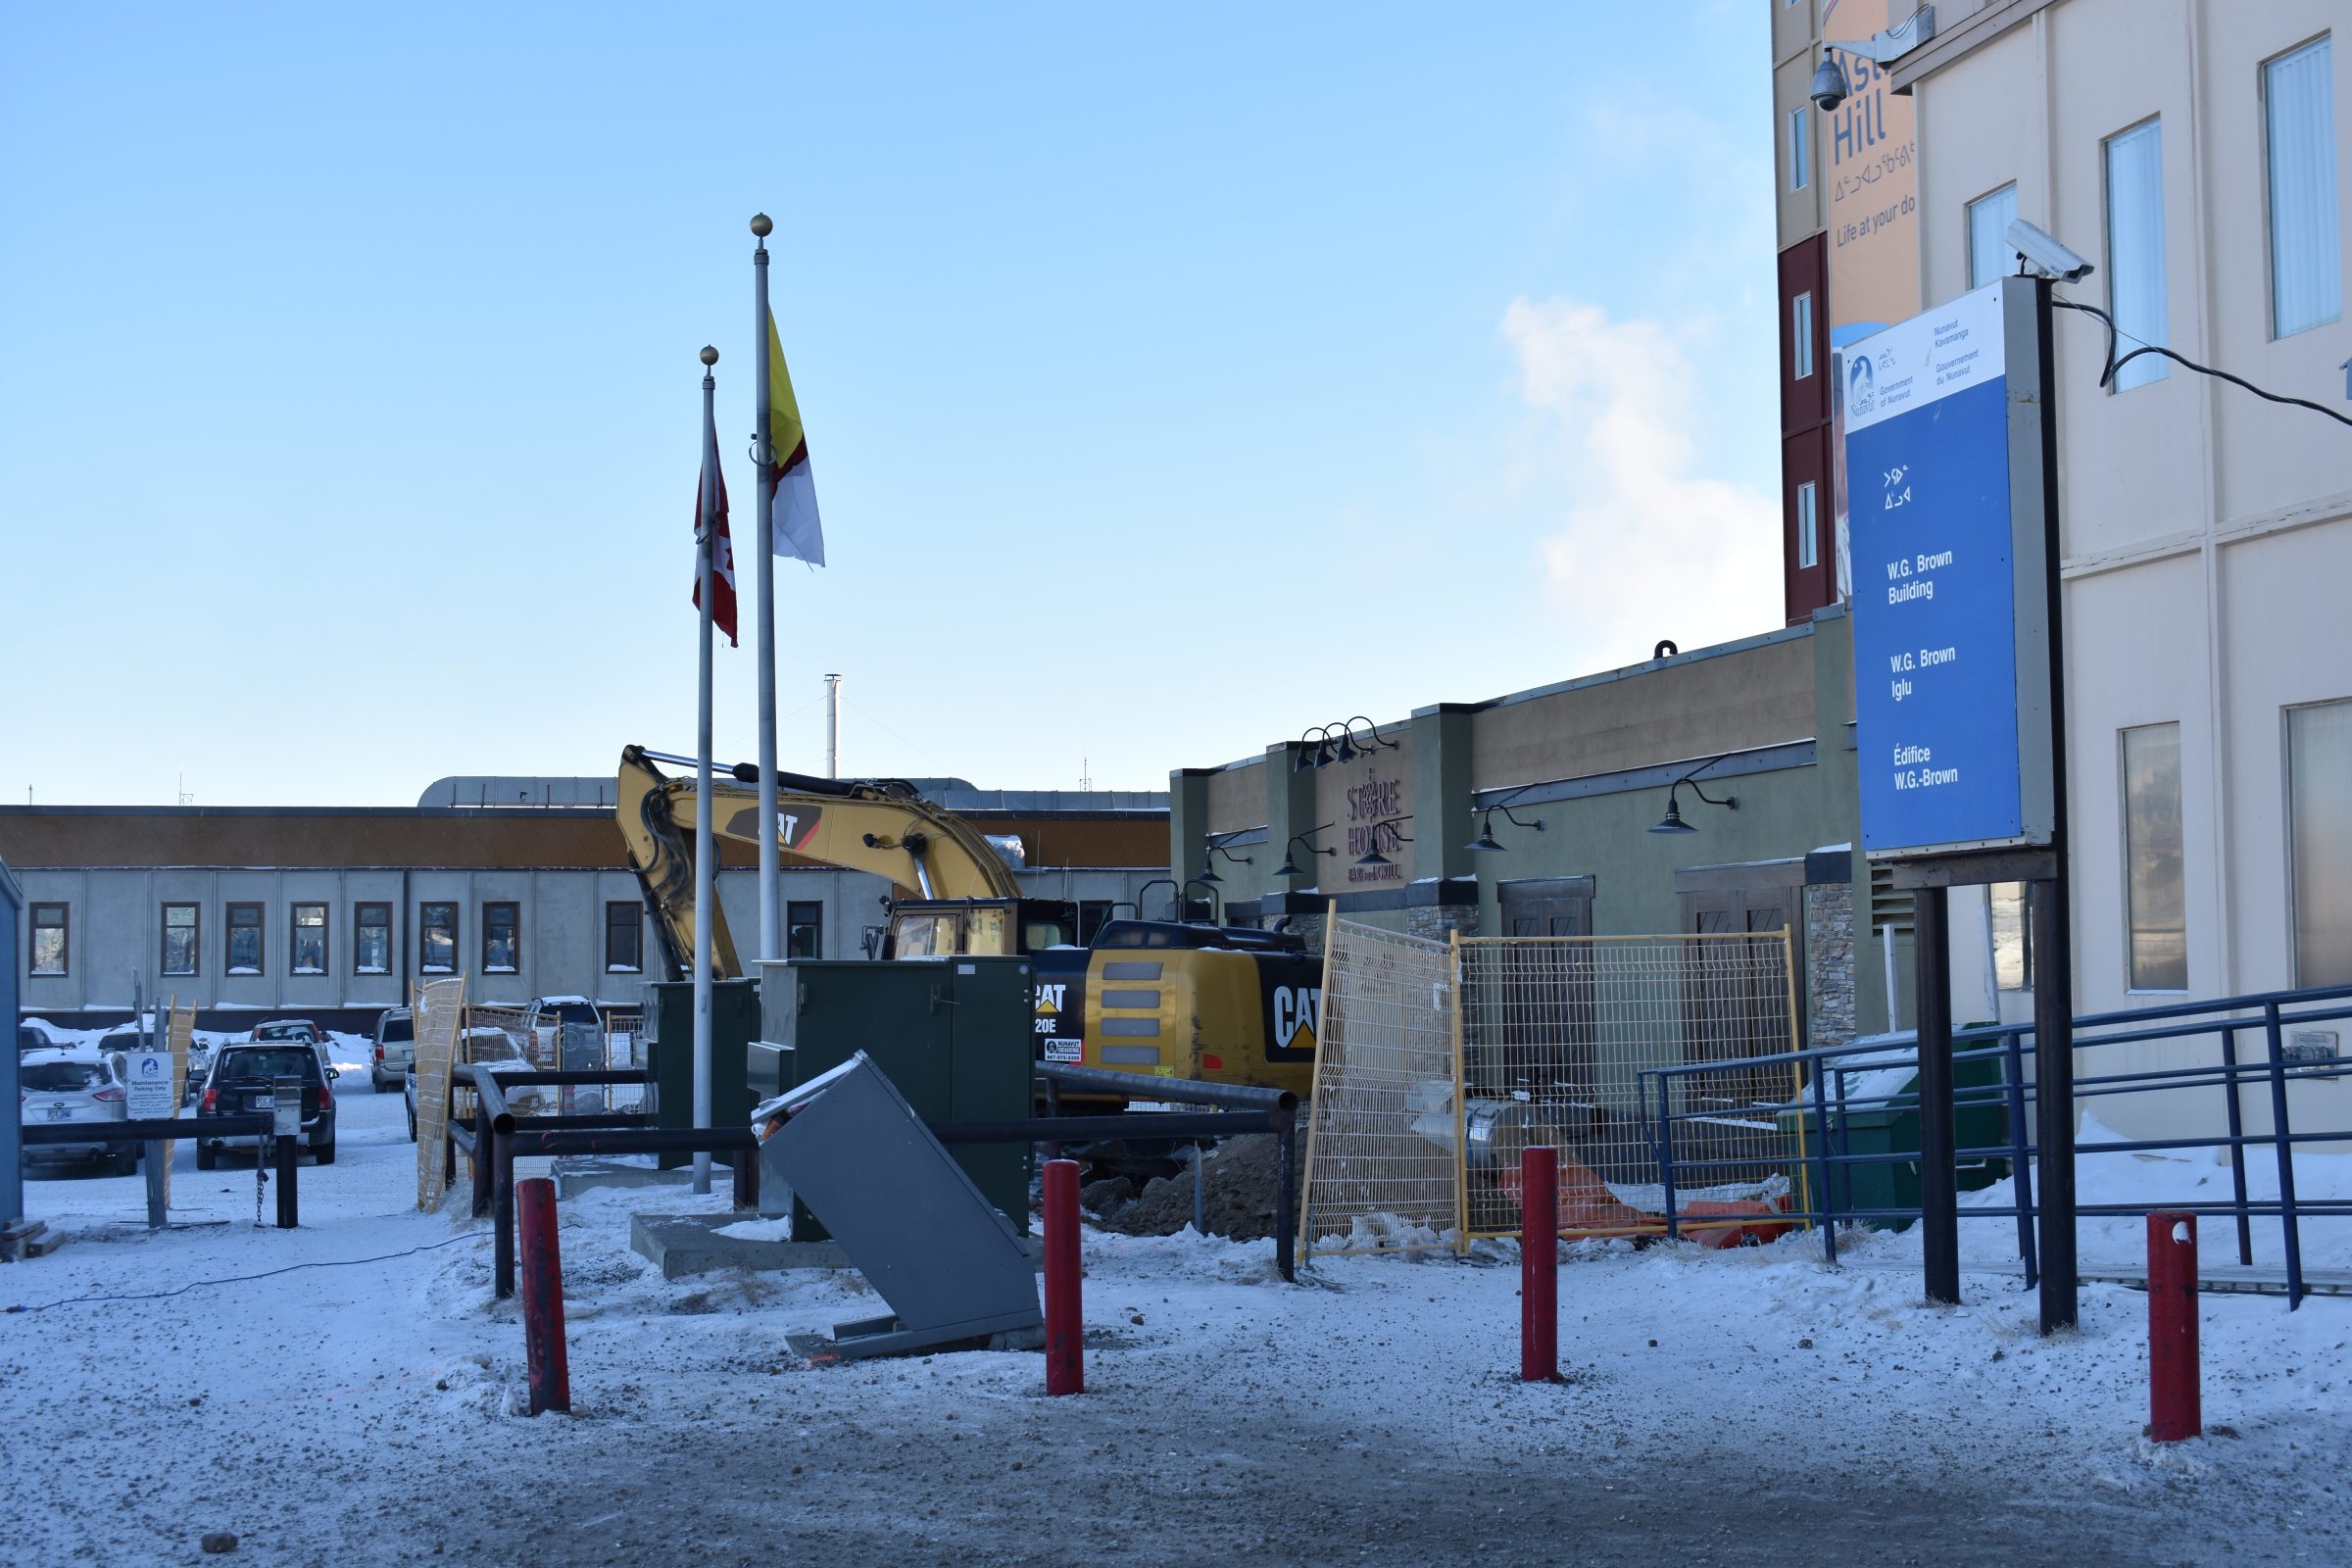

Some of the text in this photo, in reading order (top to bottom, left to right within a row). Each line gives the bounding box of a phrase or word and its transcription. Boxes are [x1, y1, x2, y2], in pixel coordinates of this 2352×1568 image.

[1837, 50, 1889, 97] Ast
[1834, 88, 1886, 166] Hill
[1837, 222, 1857, 248] Life
[1859, 215, 1871, 236] at
[1873, 205, 1897, 235] your
[1934, 318, 1958, 336] Nunavut
[1935, 328, 1969, 349] Kavamanga
[1936, 348, 1979, 373] Gouvernement
[1880, 375, 1913, 396] Government
[1936, 365, 1971, 386] du Nunavut
[1880, 389, 1911, 408] of Nunavut
[1886, 550, 1953, 580] W.G. Brown
[1888, 579, 1934, 605] Building
[1890, 646, 1956, 673] W.G. Brown
[1891, 678, 1912, 702] Iglu
[1893, 743, 1931, 766] Édifice
[1893, 767, 1958, 791] W.G.-Brown
[1377, 863, 1402, 879] GRILL
